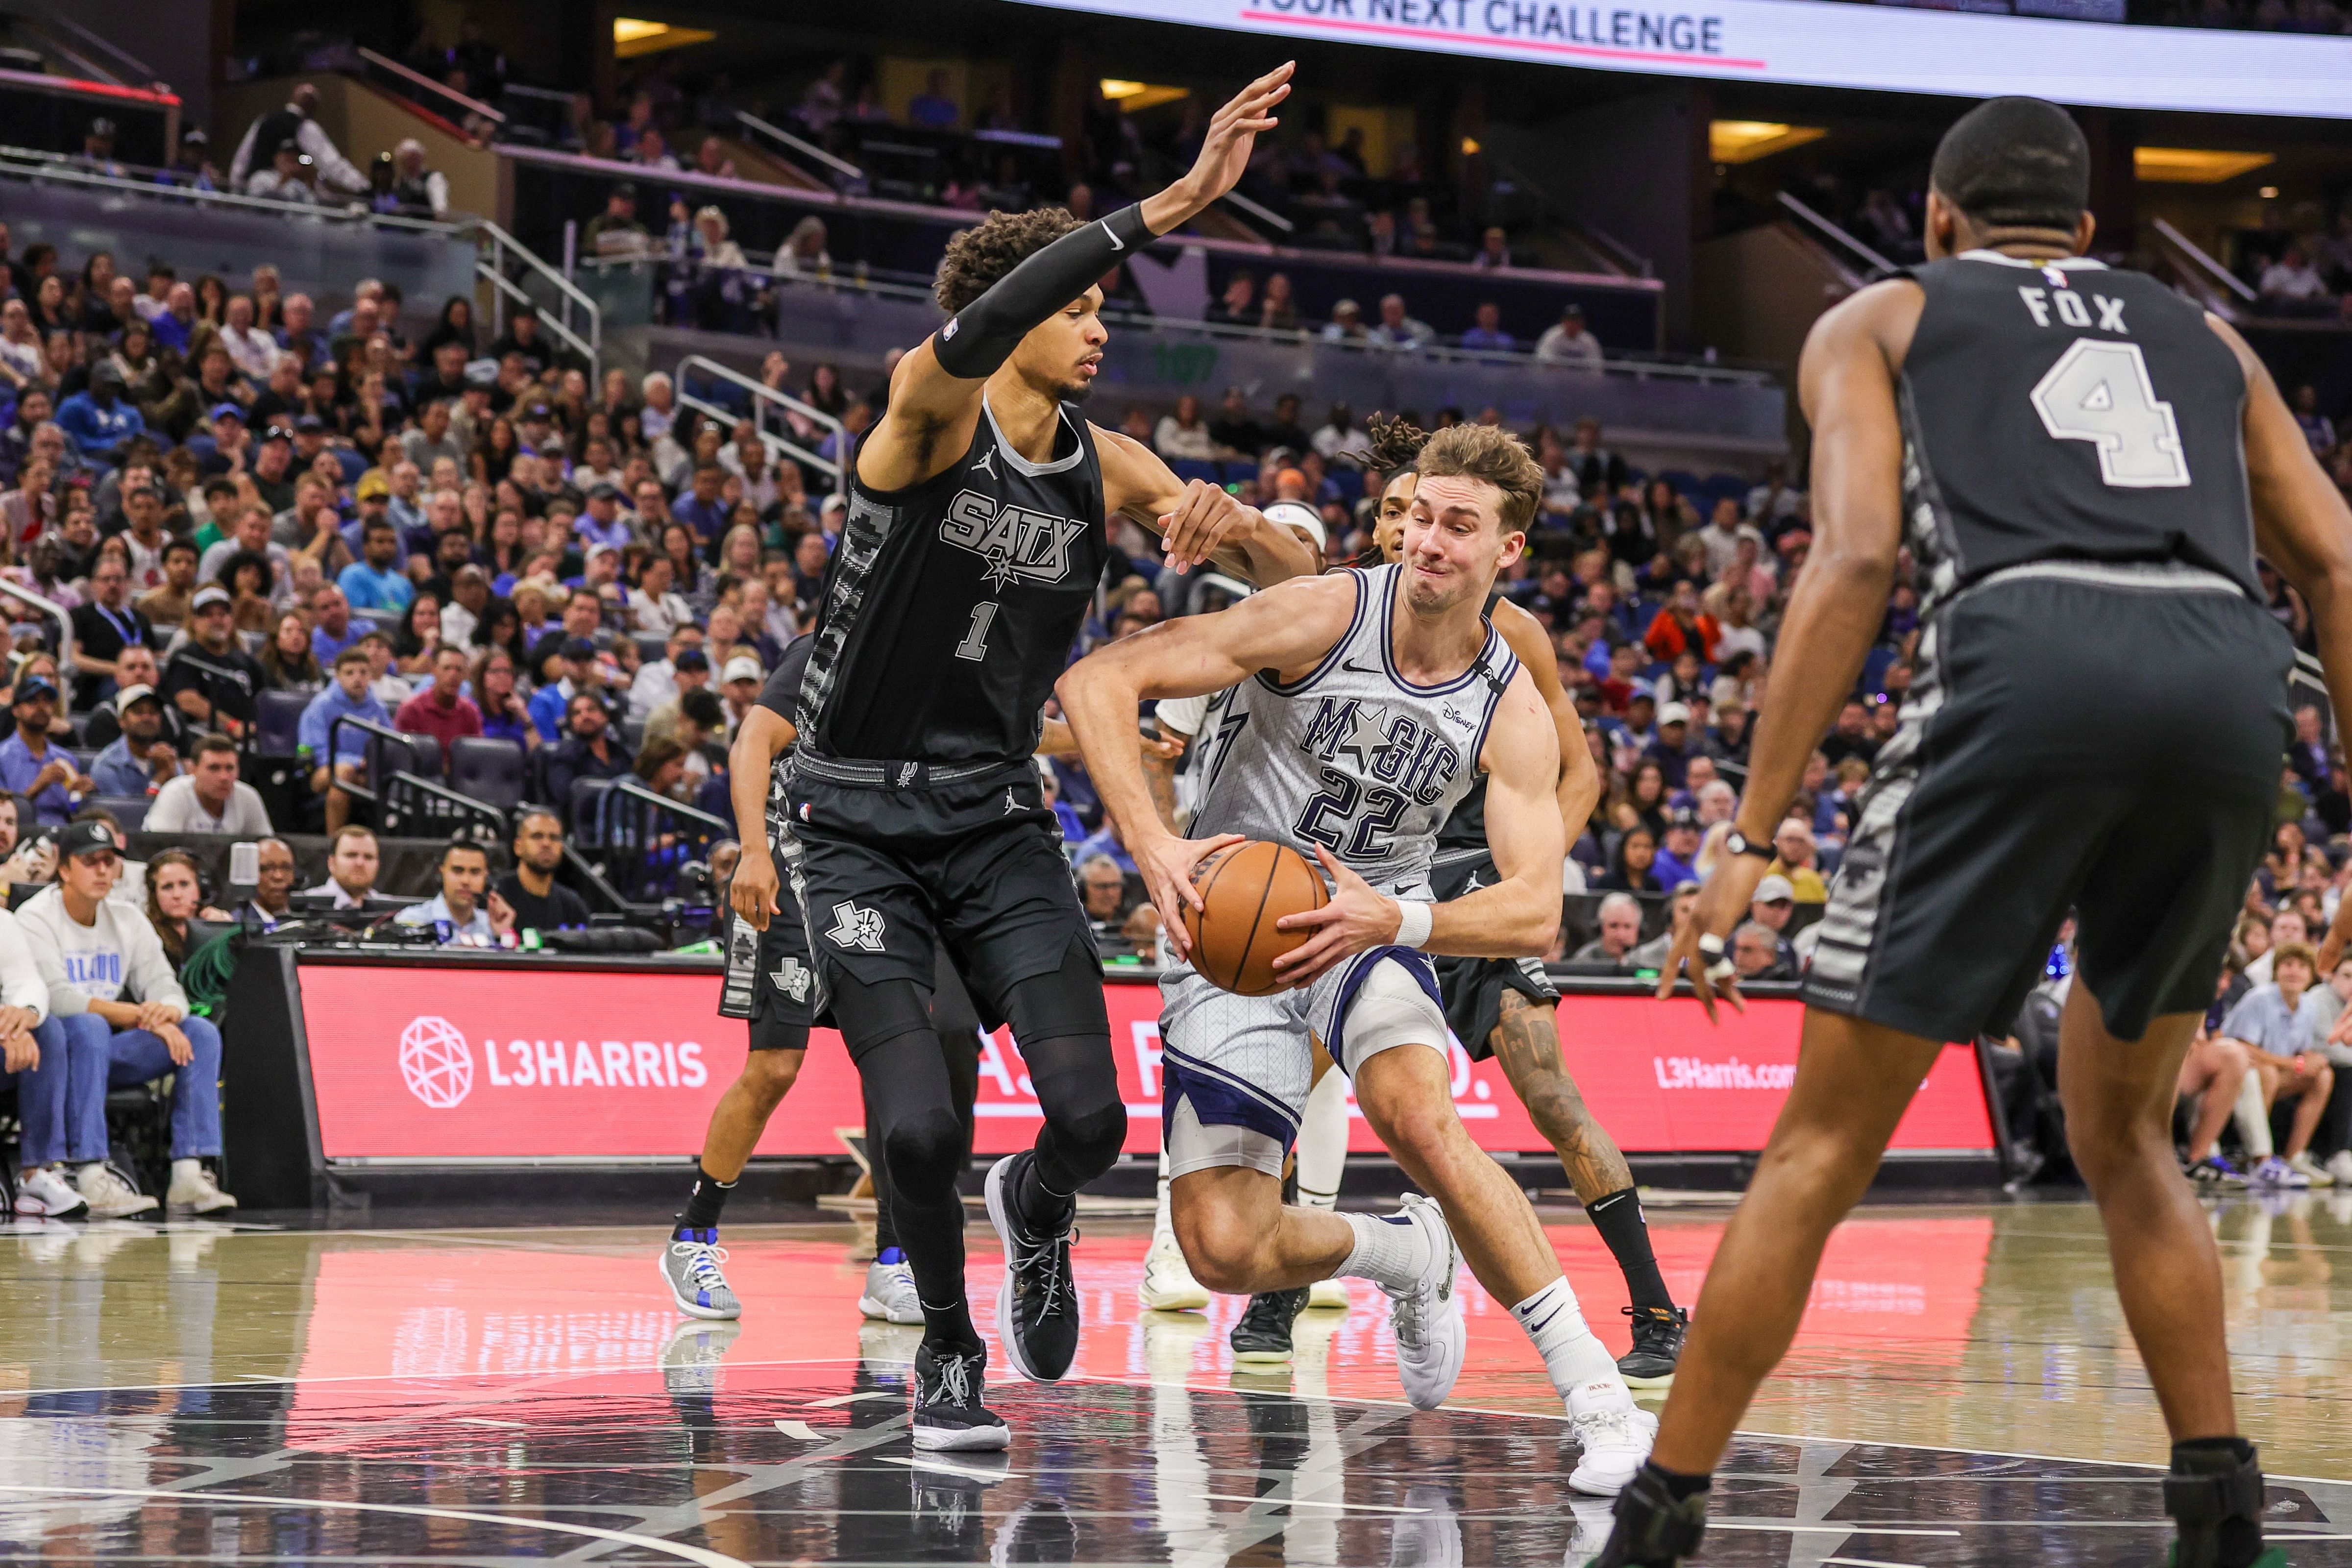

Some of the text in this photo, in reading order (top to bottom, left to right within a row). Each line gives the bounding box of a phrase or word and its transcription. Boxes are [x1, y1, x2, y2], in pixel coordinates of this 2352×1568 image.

[1485, 0, 1722, 52] CHALLENGE
[2018, 285, 2130, 334] FOX
[2030, 337, 2191, 487] 4
[939, 489, 1088, 588] SATX
[956, 601, 999, 662] 1
[1293, 766, 1411, 858] 22
[485, 1039, 708, 1087] L3HARRIS
